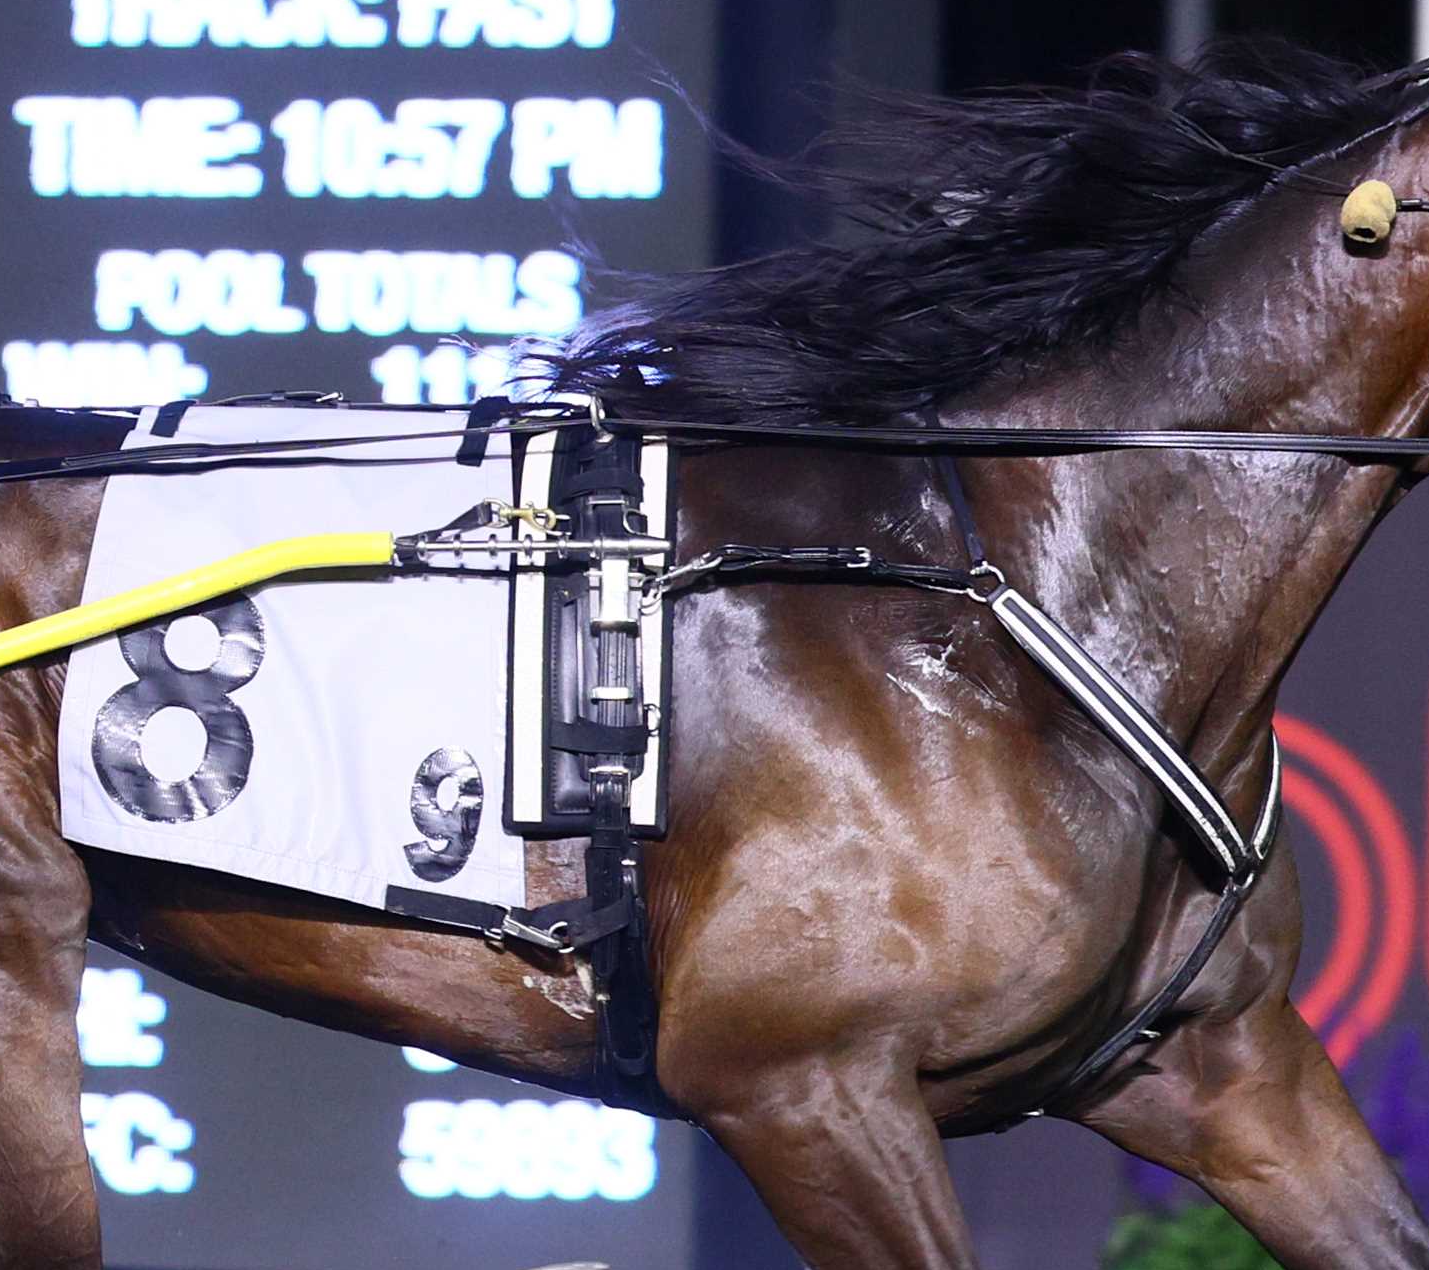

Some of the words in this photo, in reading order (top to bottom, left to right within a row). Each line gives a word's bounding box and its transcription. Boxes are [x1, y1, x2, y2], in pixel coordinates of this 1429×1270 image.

[12, 93, 264, 198] TIME:
[269, 97, 506, 198] 10:57
[511, 96, 665, 198] PM
[94, 249, 306, 335] POOL
[302, 249, 584, 335] TOTALS
[91, 585, 266, 823] 8
[401, 745, 484, 884] 9
